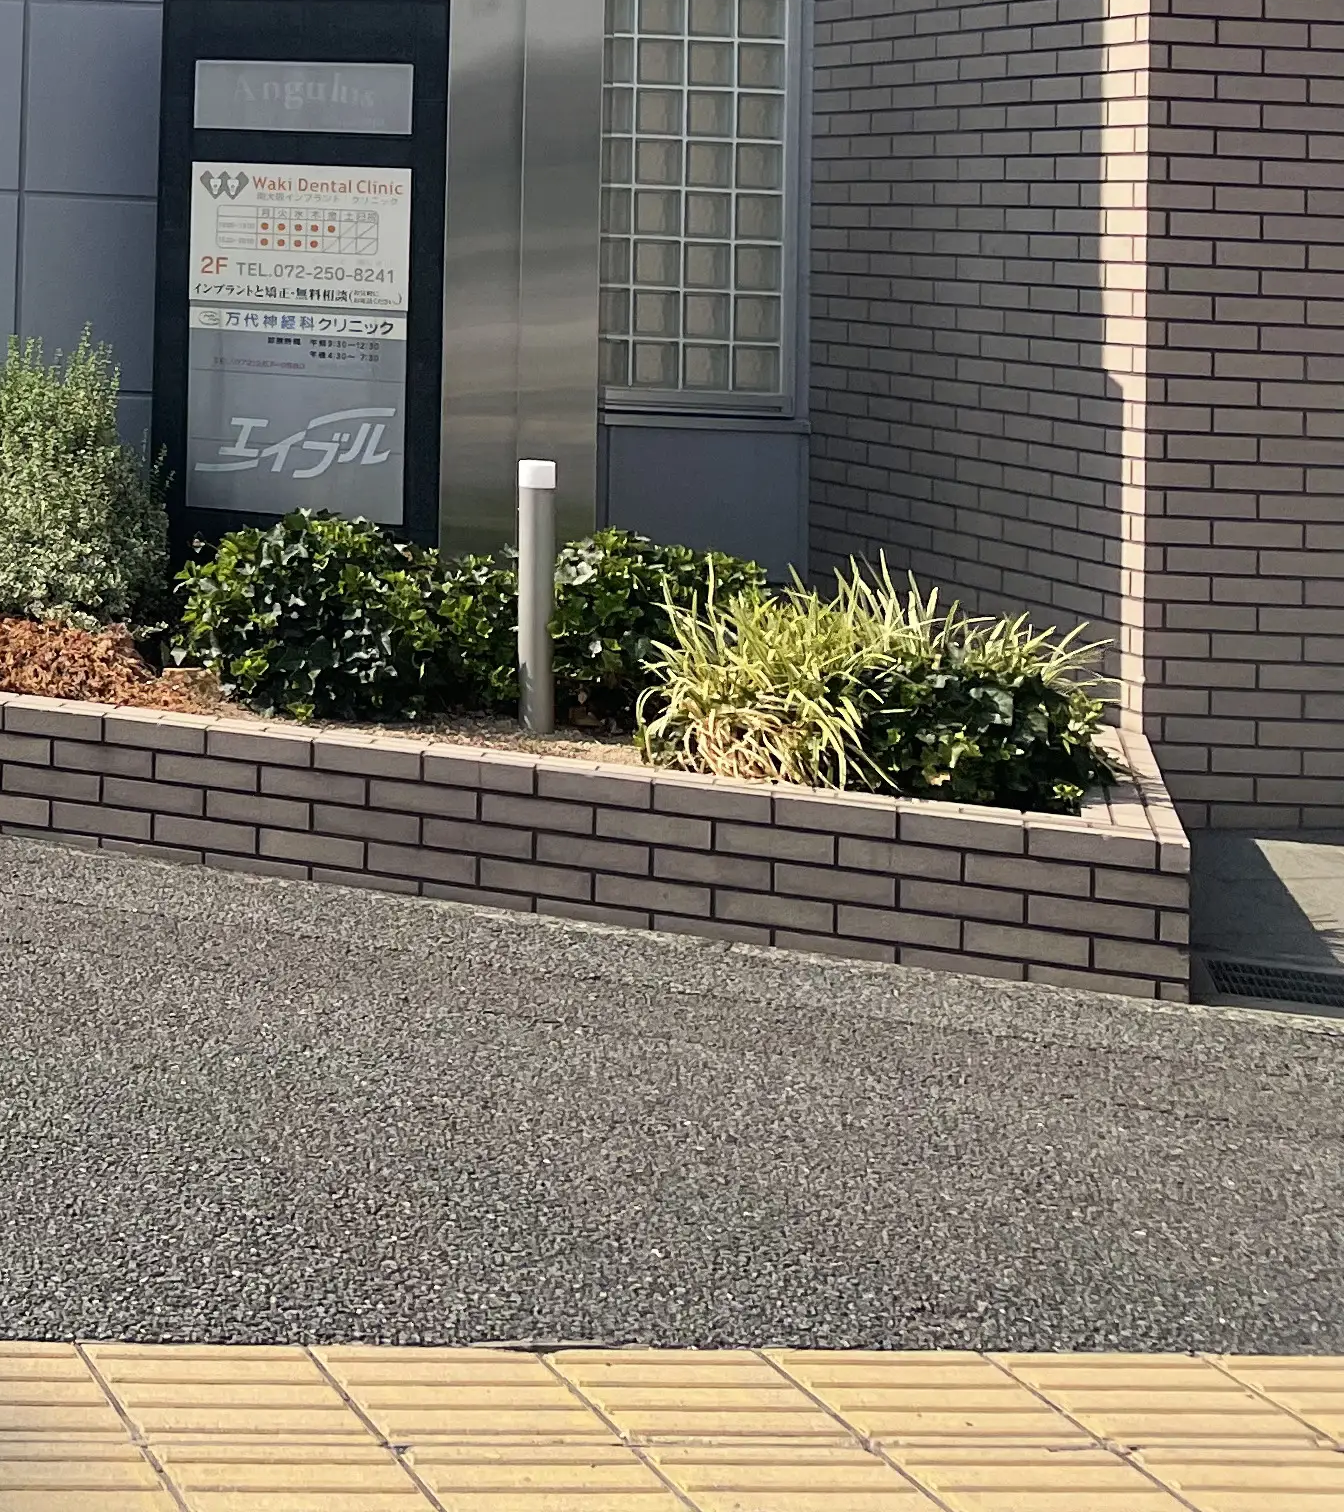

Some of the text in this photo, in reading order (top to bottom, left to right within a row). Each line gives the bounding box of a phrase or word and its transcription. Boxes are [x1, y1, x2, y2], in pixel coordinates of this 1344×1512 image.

[252, 175, 404, 196] Waki Dental Clinic
[200, 255, 396, 284] 2F TEL.072-250-8241
[225, 311, 395, 336] 万代神経科クリニック
[193, 406, 397, 479] エイブル
